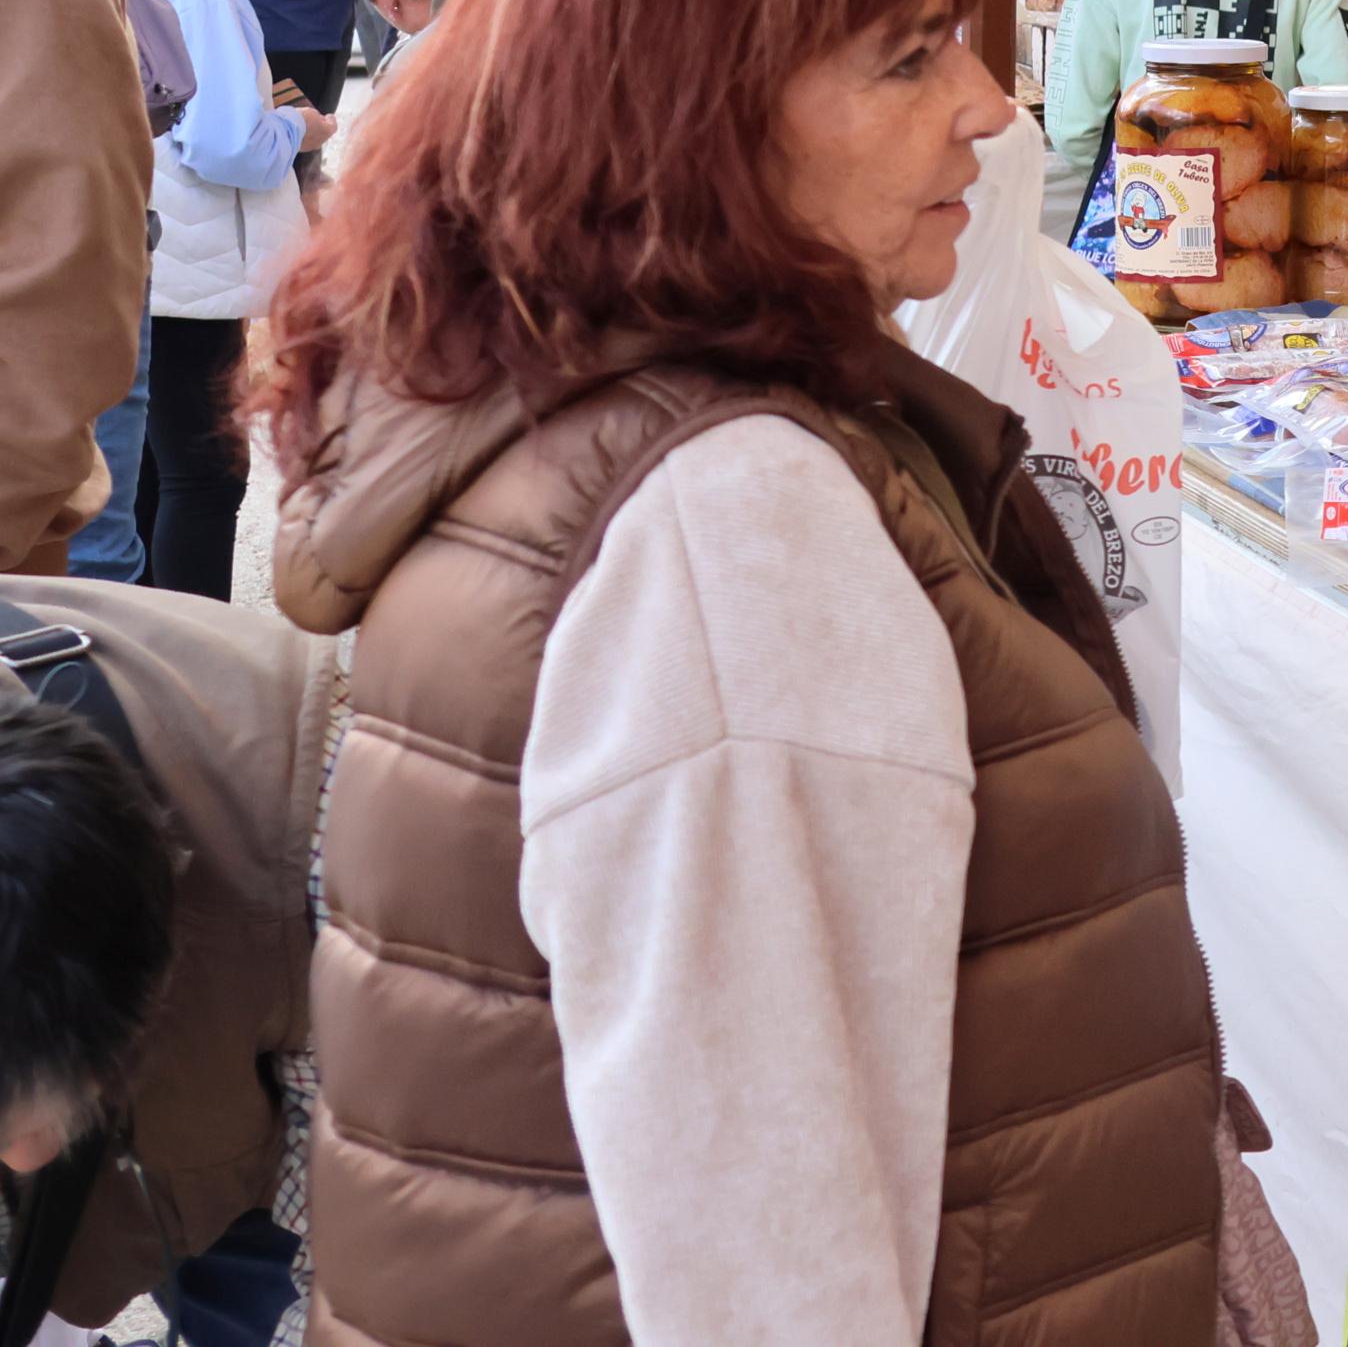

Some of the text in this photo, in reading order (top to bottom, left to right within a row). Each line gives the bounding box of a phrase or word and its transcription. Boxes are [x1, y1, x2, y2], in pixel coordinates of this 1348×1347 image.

[1184, 160, 1209, 173] Casa
[1178, 169, 1210, 184] Tubero
[1084, 489, 1112, 524] DEL
[1103, 527, 1124, 590] BREZO
